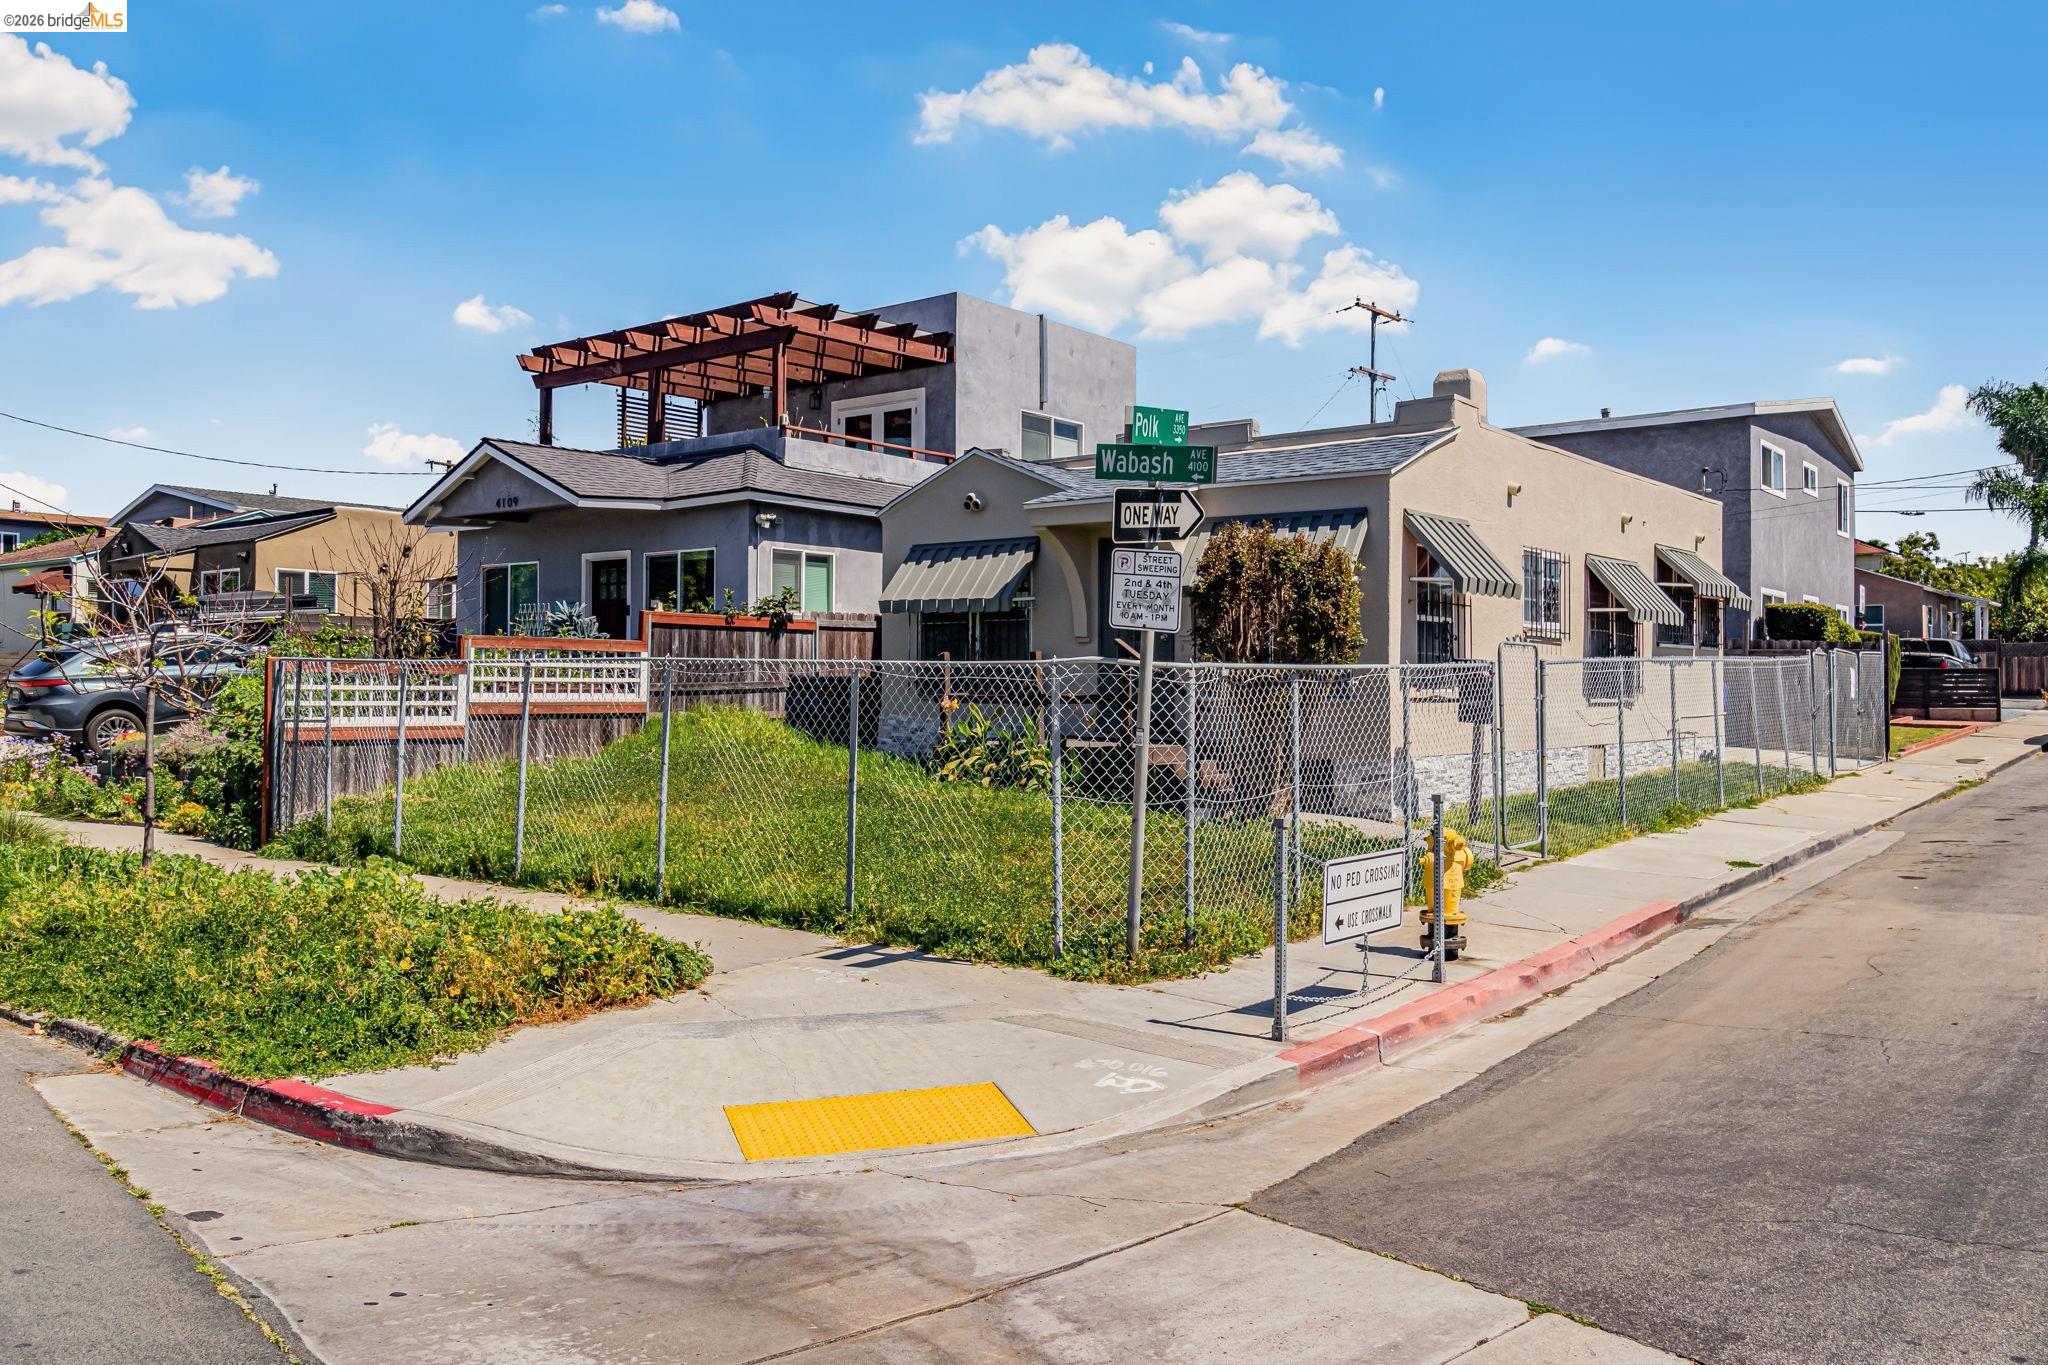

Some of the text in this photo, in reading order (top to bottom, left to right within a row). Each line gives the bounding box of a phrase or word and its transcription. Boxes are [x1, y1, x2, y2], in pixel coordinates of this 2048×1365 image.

[1174, 413, 1185, 424] AVE
[1135, 412, 1159, 438] Polk
[1190, 449, 1207, 460] AVE
[1101, 449, 1174, 475] Wabash
[1187, 461, 1209, 472] 4100
[496, 497, 518, 508] 4109
[1124, 505, 1180, 526] ONE WAY
[1142, 555, 1173, 565] STREET
[1137, 565, 1178, 574] SWEEPING
[1124, 578, 1173, 589] 2nd & 4th
[1124, 589, 1170, 600] TUESDAY
[1116, 601, 1175, 613] EVERY MONTH
[1151, 613, 1168, 622] 1PM
[1330, 863, 1400, 891] NO PED CROSSING
[1347, 904, 1392, 929] USE CROSSWALK
